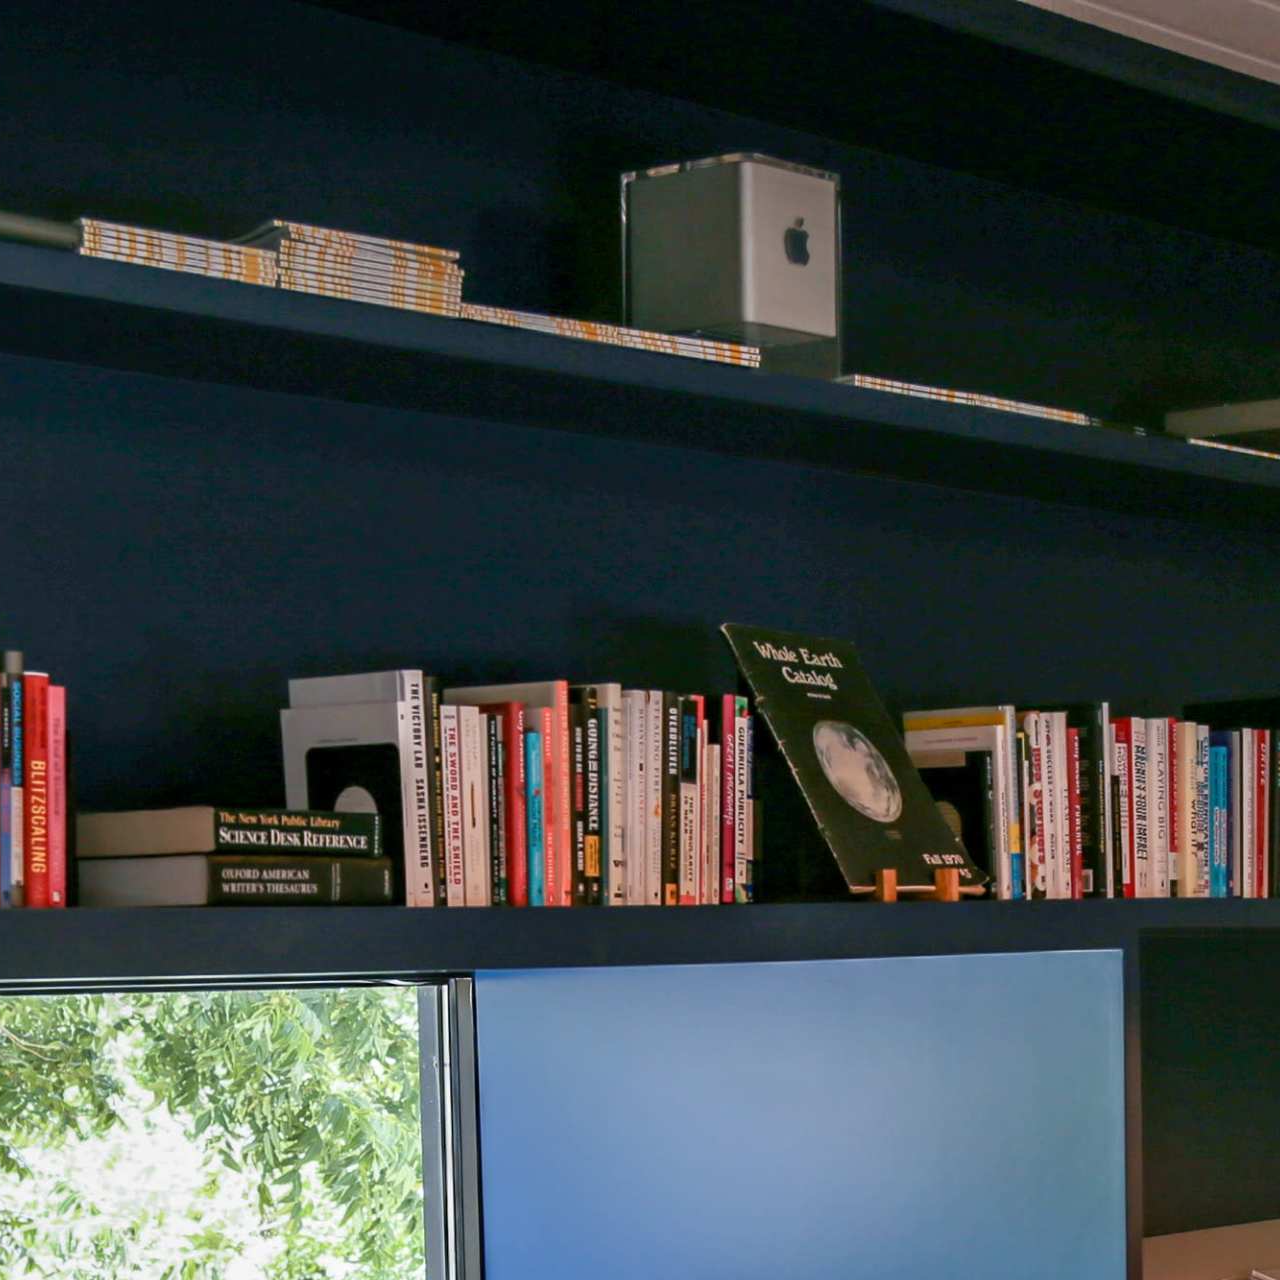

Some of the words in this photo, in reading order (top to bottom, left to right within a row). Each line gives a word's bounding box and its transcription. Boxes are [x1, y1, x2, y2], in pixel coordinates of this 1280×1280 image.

[753, 641, 798, 663] Whole
[800, 648, 843, 669] Earth
[411, 683, 420, 700] THE
[782, 666, 838, 690] Catalog
[412, 705, 423, 746] VICTORY
[448, 727, 456, 746] THE
[587, 718, 599, 761] GOING
[668, 708, 678, 776] OVERDELIVER
[414, 750, 423, 769] LAB
[449, 752, 458, 791] SWORD
[736, 727, 746, 786] GUERRILLA
[1135, 745, 1147, 791] MAGNIFY
[415, 778, 425, 810] SASHA
[1157, 752, 1165, 812] PLAYING
[30, 759, 47, 874] BLITZSCALING
[451, 794, 459, 817] AND
[588, 773, 600, 831] DISTANCE
[737, 790, 747, 846] PUBLICITY
[1136, 794, 1147, 822] YOUR
[220, 812, 236, 824] The
[239, 813, 258, 825] New
[259, 814, 278, 826] York
[281, 815, 307, 827] Public
[310, 816, 341, 830] Library
[452, 821, 460, 841] THE
[219, 827, 268, 845] SCIENCE
[271, 829, 301, 847] DESK
[303, 831, 368, 850] REFERENCE
[418, 814, 429, 869] ISSENBERG
[1136, 824, 1148, 861] IMPACT
[222, 868, 259, 879] OXFORD
[261, 869, 310, 880] AMERICAN
[453, 845, 462, 886] SHIELD
[222, 883, 265, 894] WRITER'S
[266, 883, 318, 895] THESAURUS
